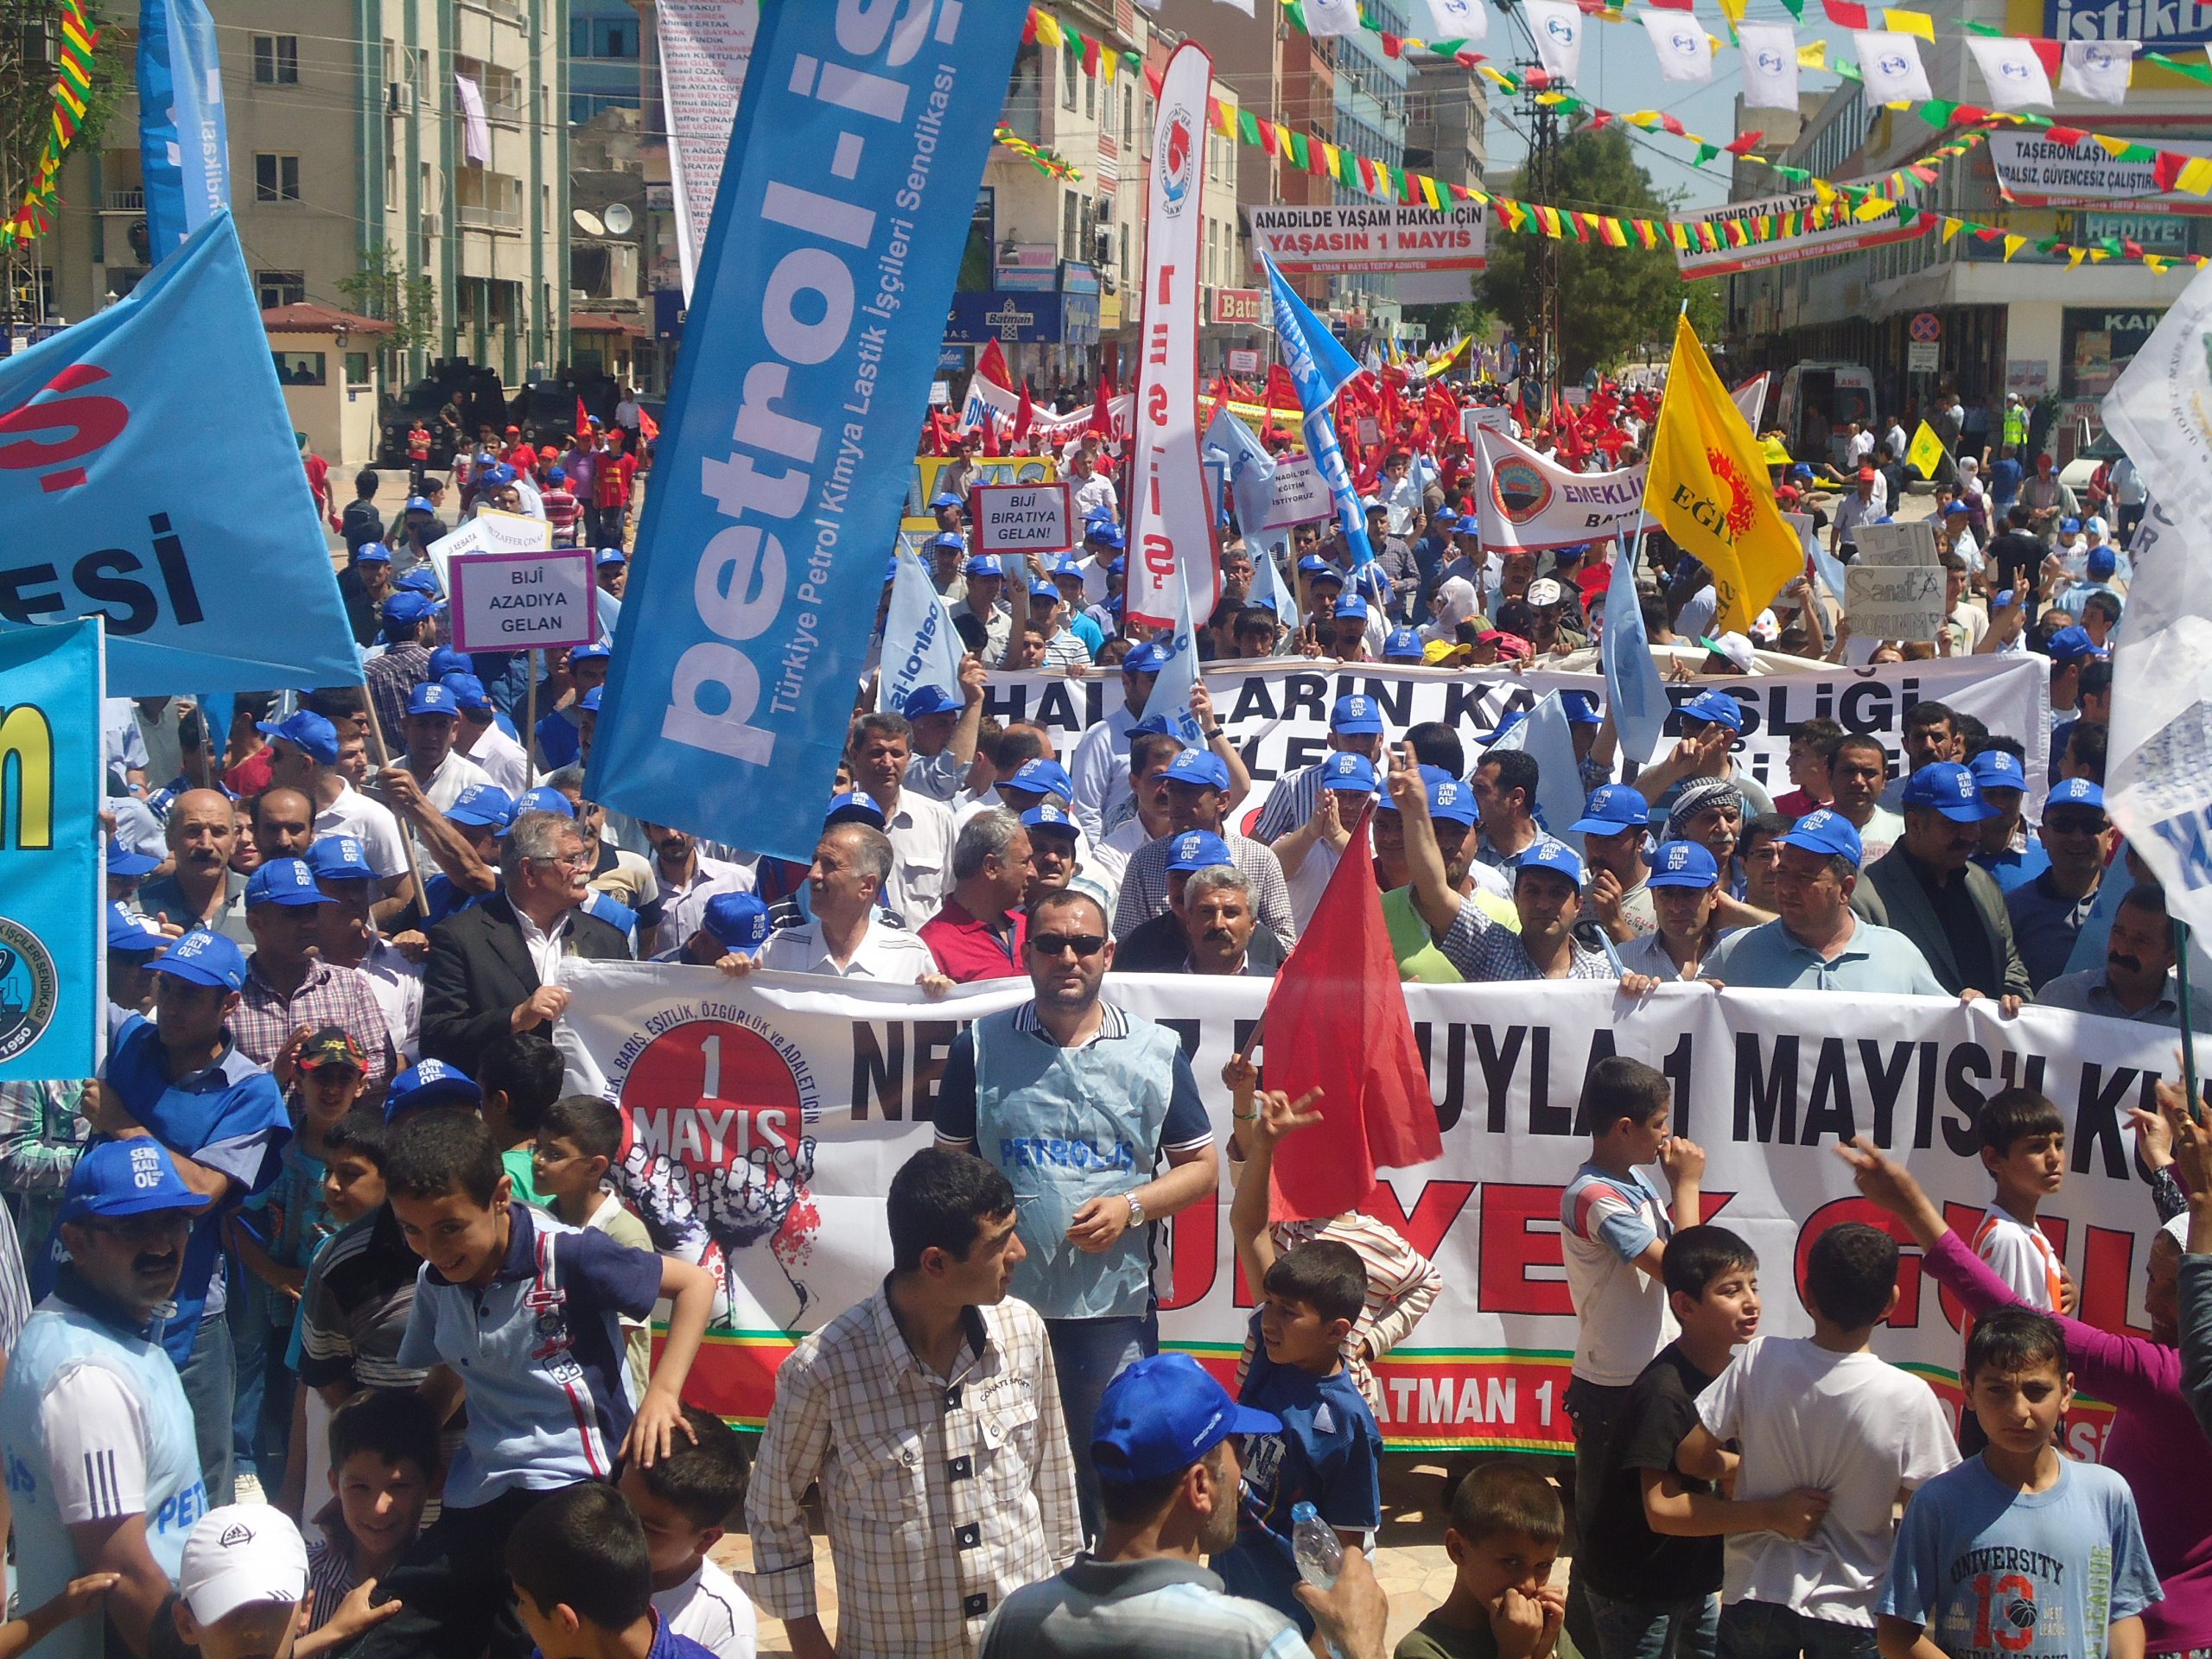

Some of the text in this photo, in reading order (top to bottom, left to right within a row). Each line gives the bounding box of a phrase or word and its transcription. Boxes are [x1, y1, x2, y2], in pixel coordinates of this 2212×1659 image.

[1255, 208, 1332, 228] ANADİLDE
[1339, 209, 1391, 232] YAŞAM
[1268, 231, 1471, 256] YAŞASIN 1 MAYIS
[988, 314, 1032, 325] Batman
[771, 62, 957, 715] Türkiye Petrol Kimya Lastik İşçileri Sendikası
[1010, 493, 1037, 507] BIJÎ
[991, 511, 1056, 524] BIRATIYA
[998, 527, 1051, 540] GELAN!
[512, 567, 543, 585] BIJÎ
[489, 592, 568, 610] AZADIYA
[501, 616, 563, 632] GELAN
[701, 1001, 771, 1036] ÖZGÜRLÜK
[770, 1031, 785, 1047] ve
[781, 1043, 816, 1092] ADALET
[700, 1034, 720, 1100] 1
[632, 1106, 788, 1166] MAYIS
[1535, 1381, 1552, 1426] 1
[1950, 1546, 2064, 1586] UNIVERSITY
[1972, 1573, 2034, 1652] 13
